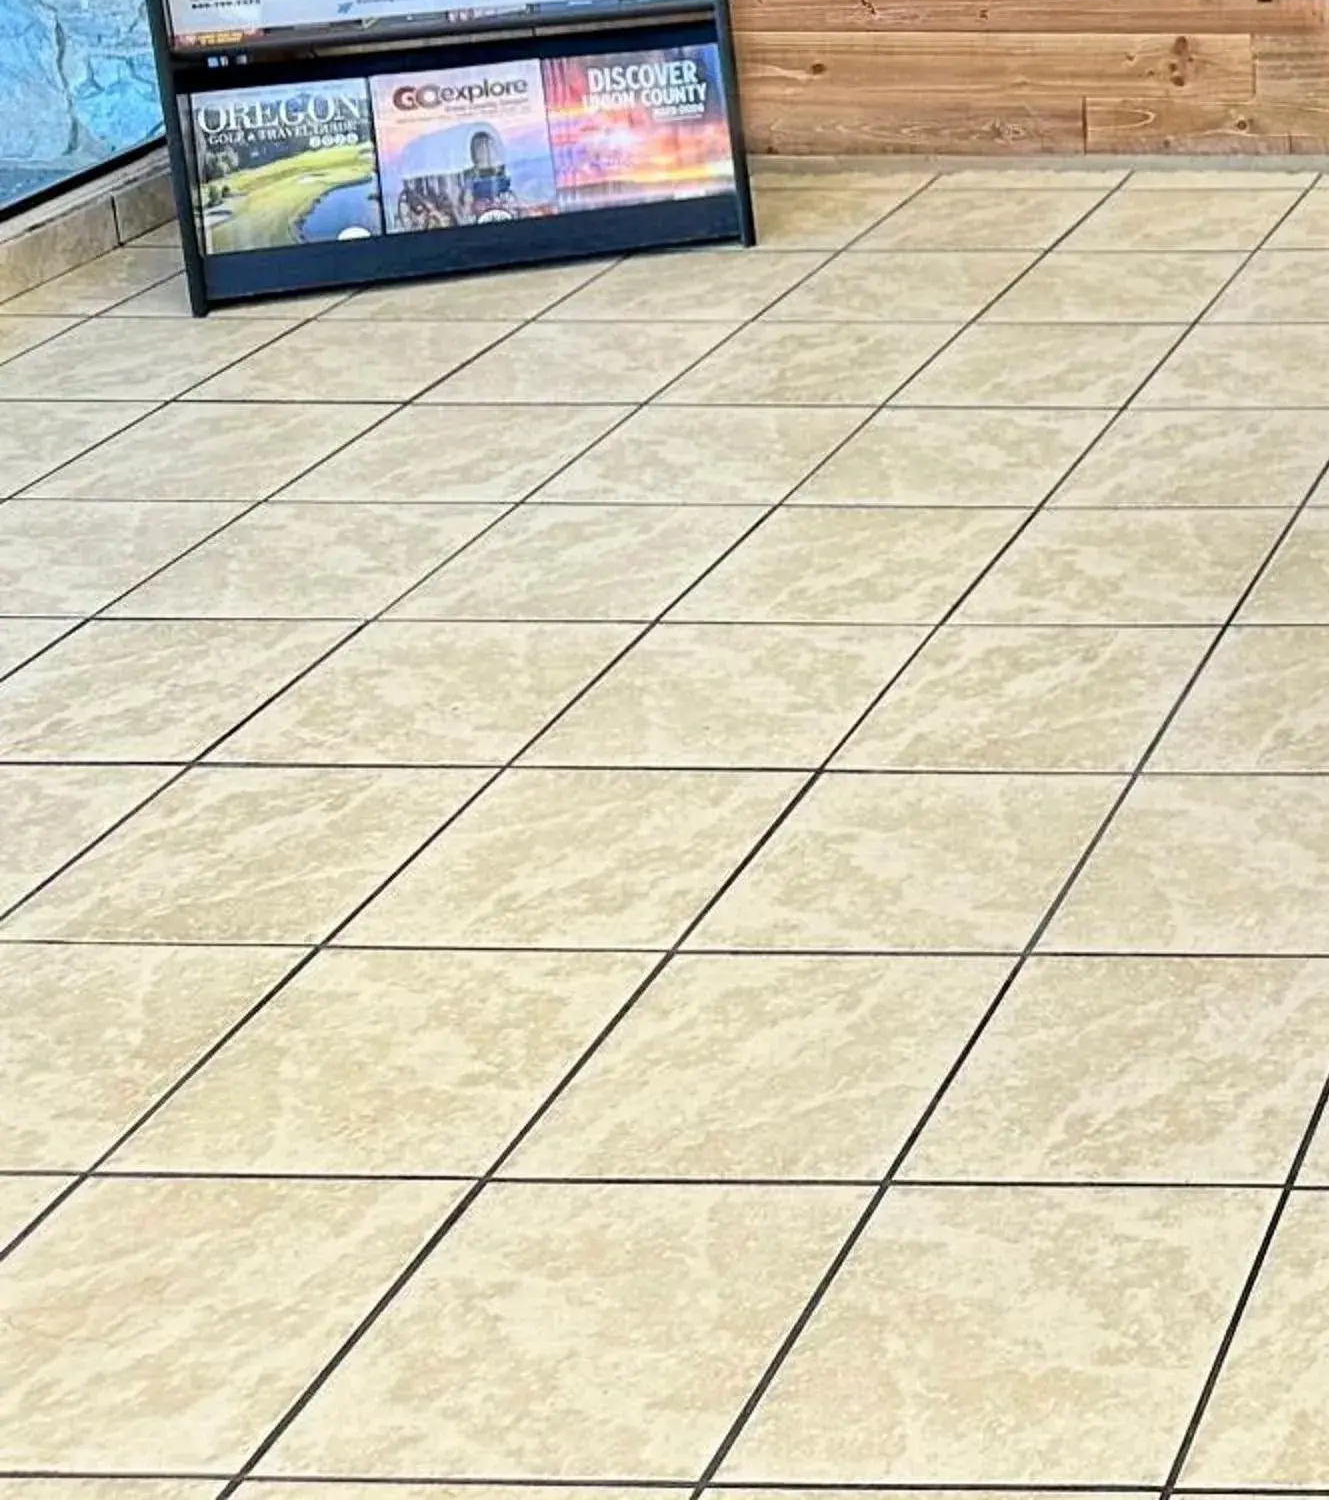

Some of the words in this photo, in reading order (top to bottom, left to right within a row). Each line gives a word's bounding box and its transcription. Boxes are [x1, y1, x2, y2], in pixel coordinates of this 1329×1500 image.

[587, 60, 698, 92] DISCOVER
[582, 91, 636, 111] UNION
[641, 83, 707, 107] COUNTY
[197, 93, 362, 134] OREGON
[209, 132, 245, 146] GOLF
[257, 128, 312, 141] TRAVEL
